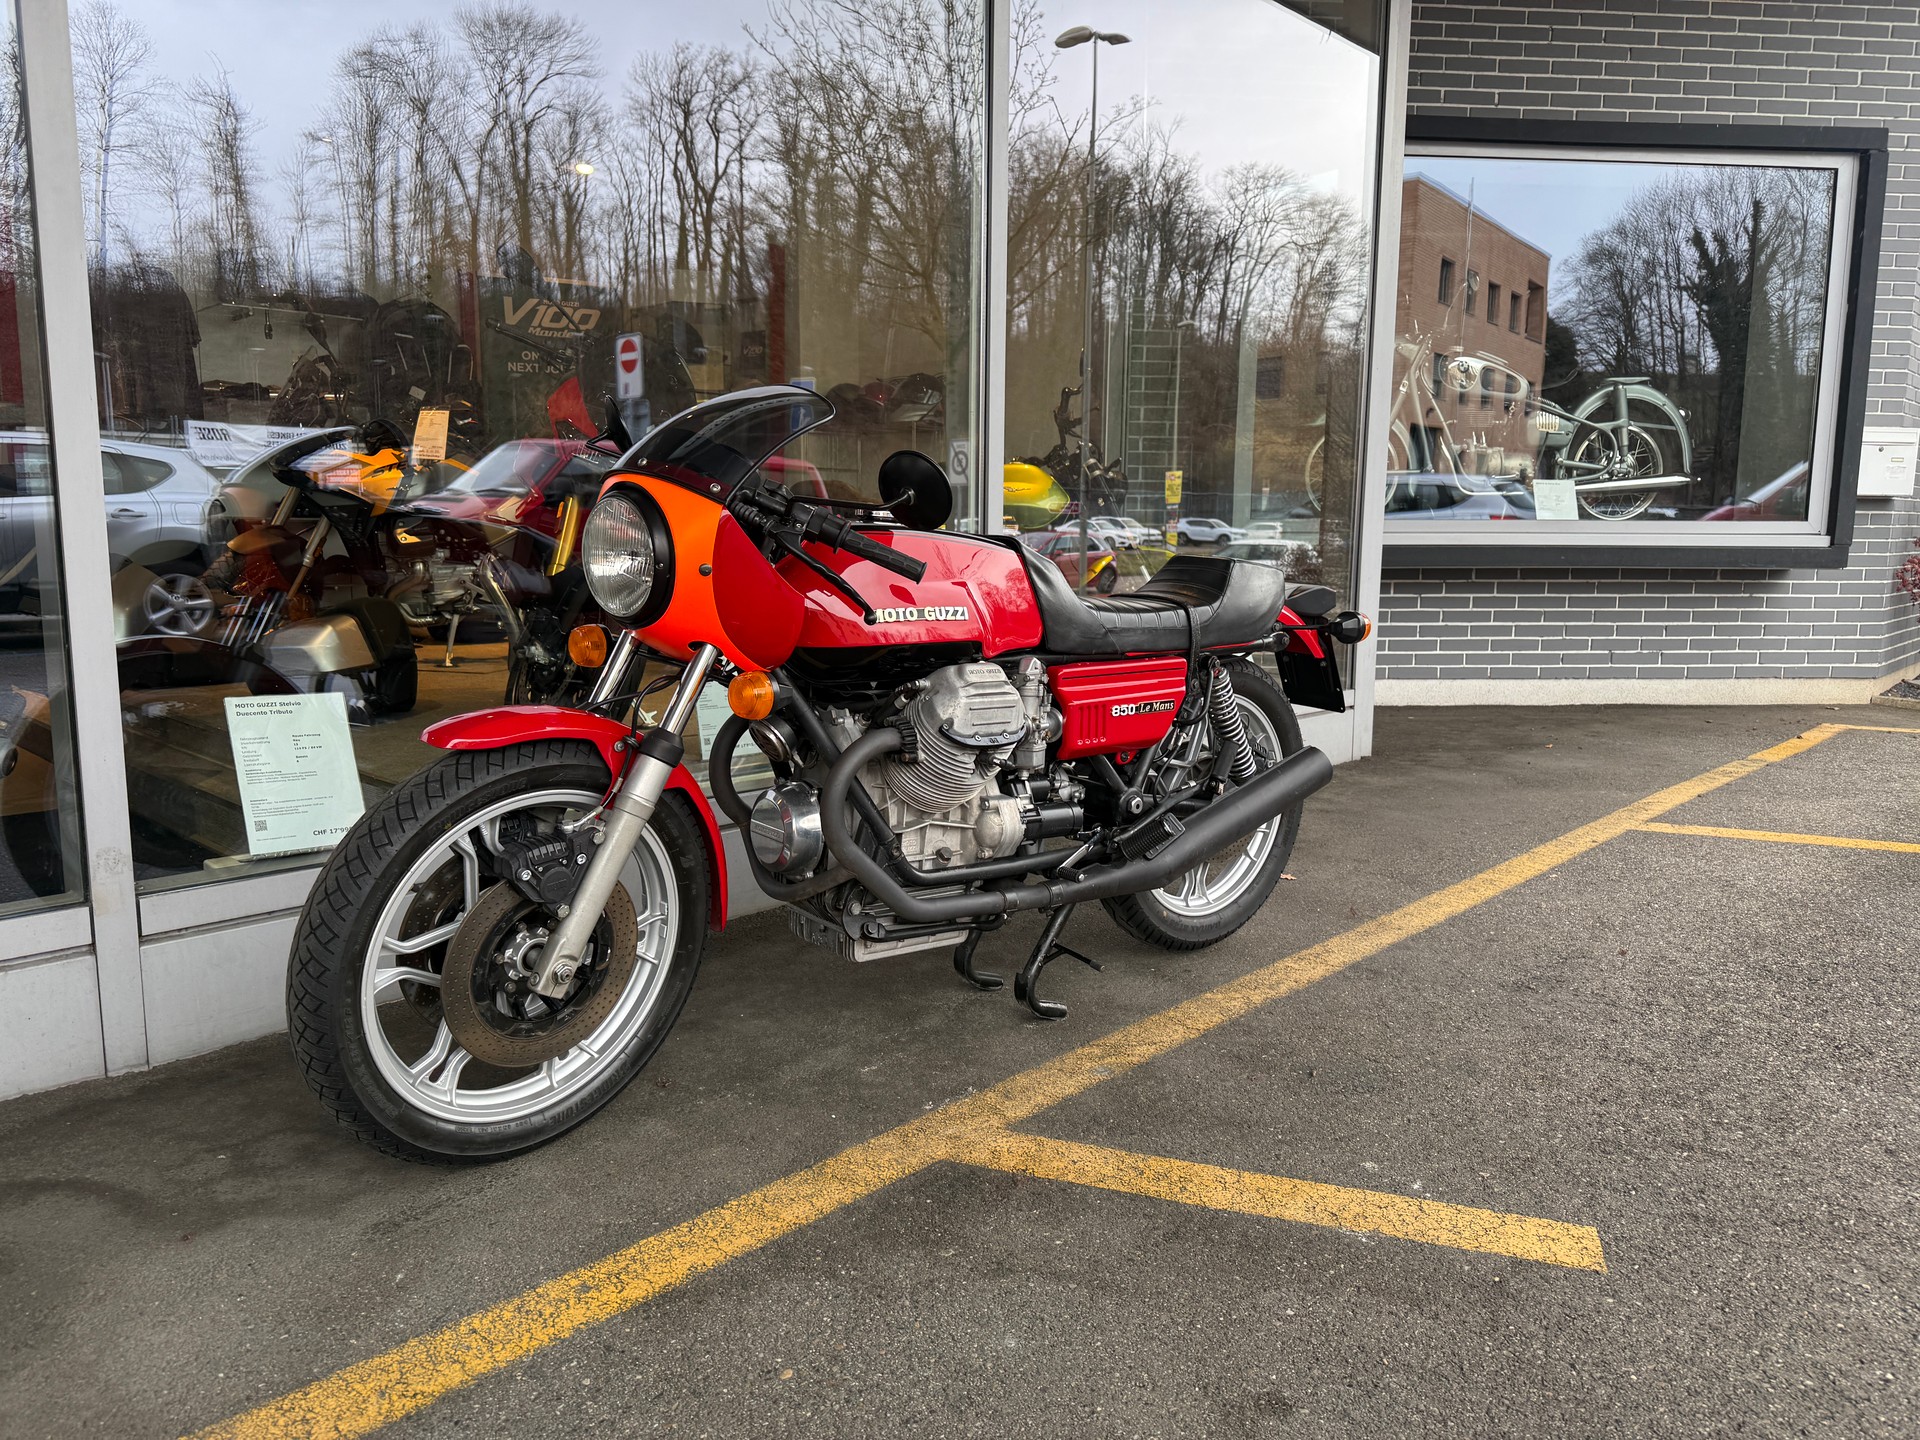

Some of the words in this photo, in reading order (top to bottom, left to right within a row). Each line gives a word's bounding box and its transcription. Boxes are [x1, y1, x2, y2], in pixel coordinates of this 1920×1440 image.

[503, 296, 601, 331] V100
[528, 327, 574, 339] Mande
[508, 362, 539, 374] NEXT
[924, 606, 969, 621] GUZZI
[1111, 703, 1136, 717] 850
[1139, 703, 1151, 713] Le
[1152, 701, 1175, 711] Mans
[312, 828, 328, 836] CHF
[329, 826, 350, 835] 17'99
